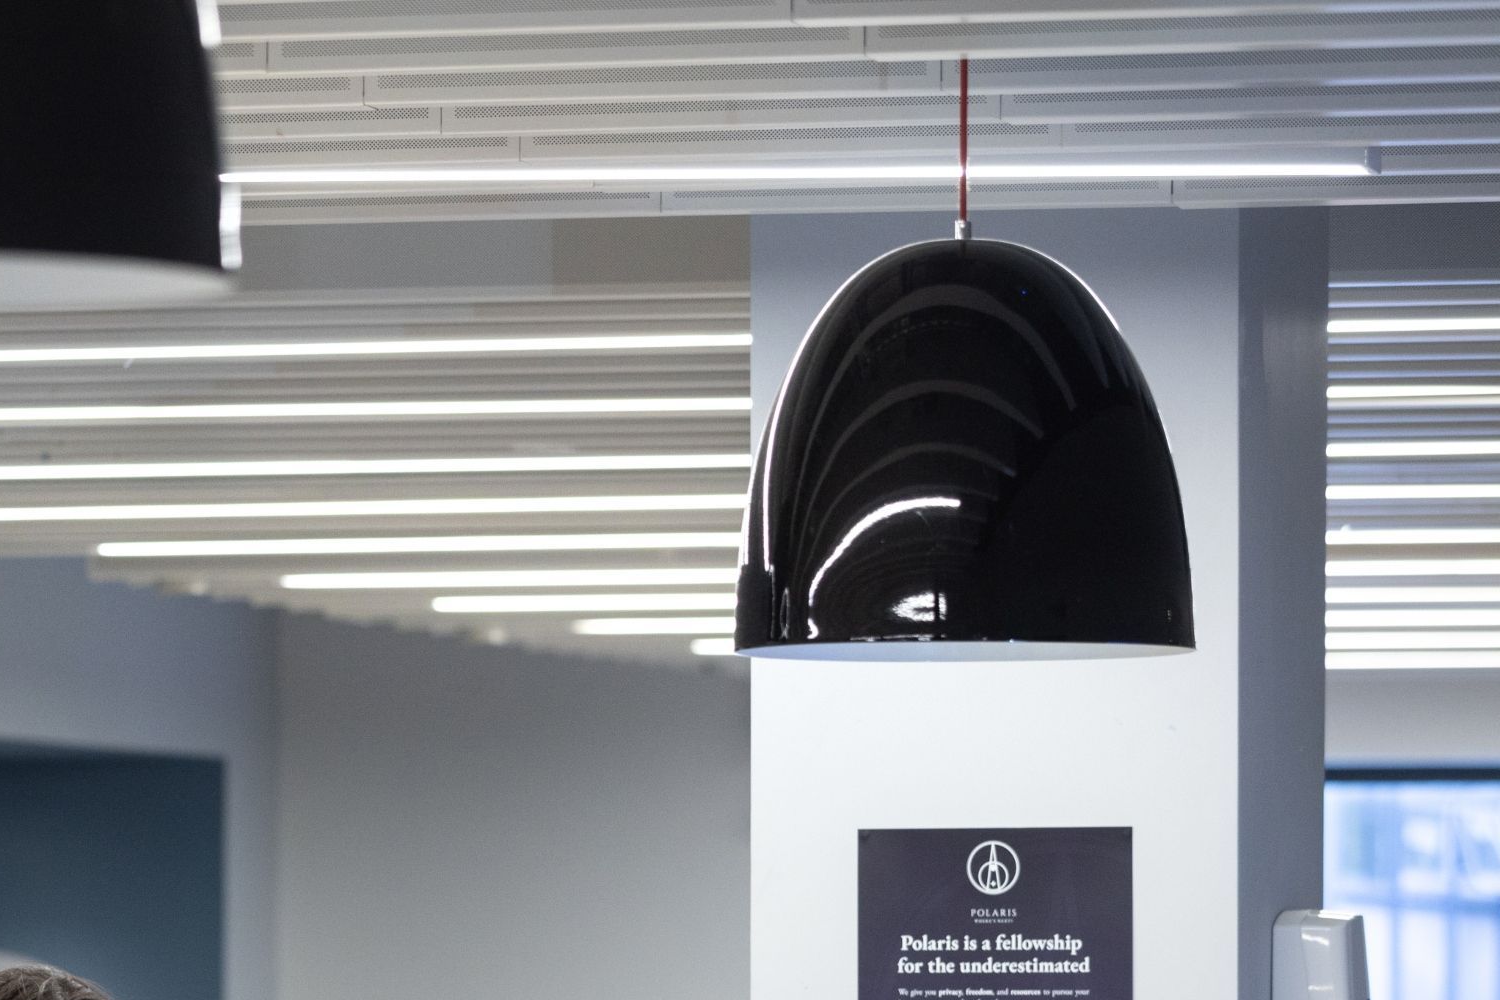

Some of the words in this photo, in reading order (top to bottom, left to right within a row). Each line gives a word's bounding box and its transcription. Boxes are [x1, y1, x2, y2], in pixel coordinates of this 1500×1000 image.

[970, 908, 1017, 917] POLARIS
[900, 934, 959, 951] Polaris
[964, 934, 977, 951] is
[981, 940, 991, 951] a
[995, 934, 1083, 955] fellowship
[897, 956, 923, 973] for
[928, 956, 955, 973] the
[960, 956, 1090, 973] underestimated
[898, 988, 909, 996] We
[910, 988, 923, 998] give
[924, 990, 936, 998] you
[938, 988, 963, 998] privacy,
[965, 988, 995, 998] freedom,
[996, 988, 1009, 996] and
[1043, 988, 1050, 996] to
[1052, 990, 1073, 998] pursue
[1075, 990, 1090, 998] your
